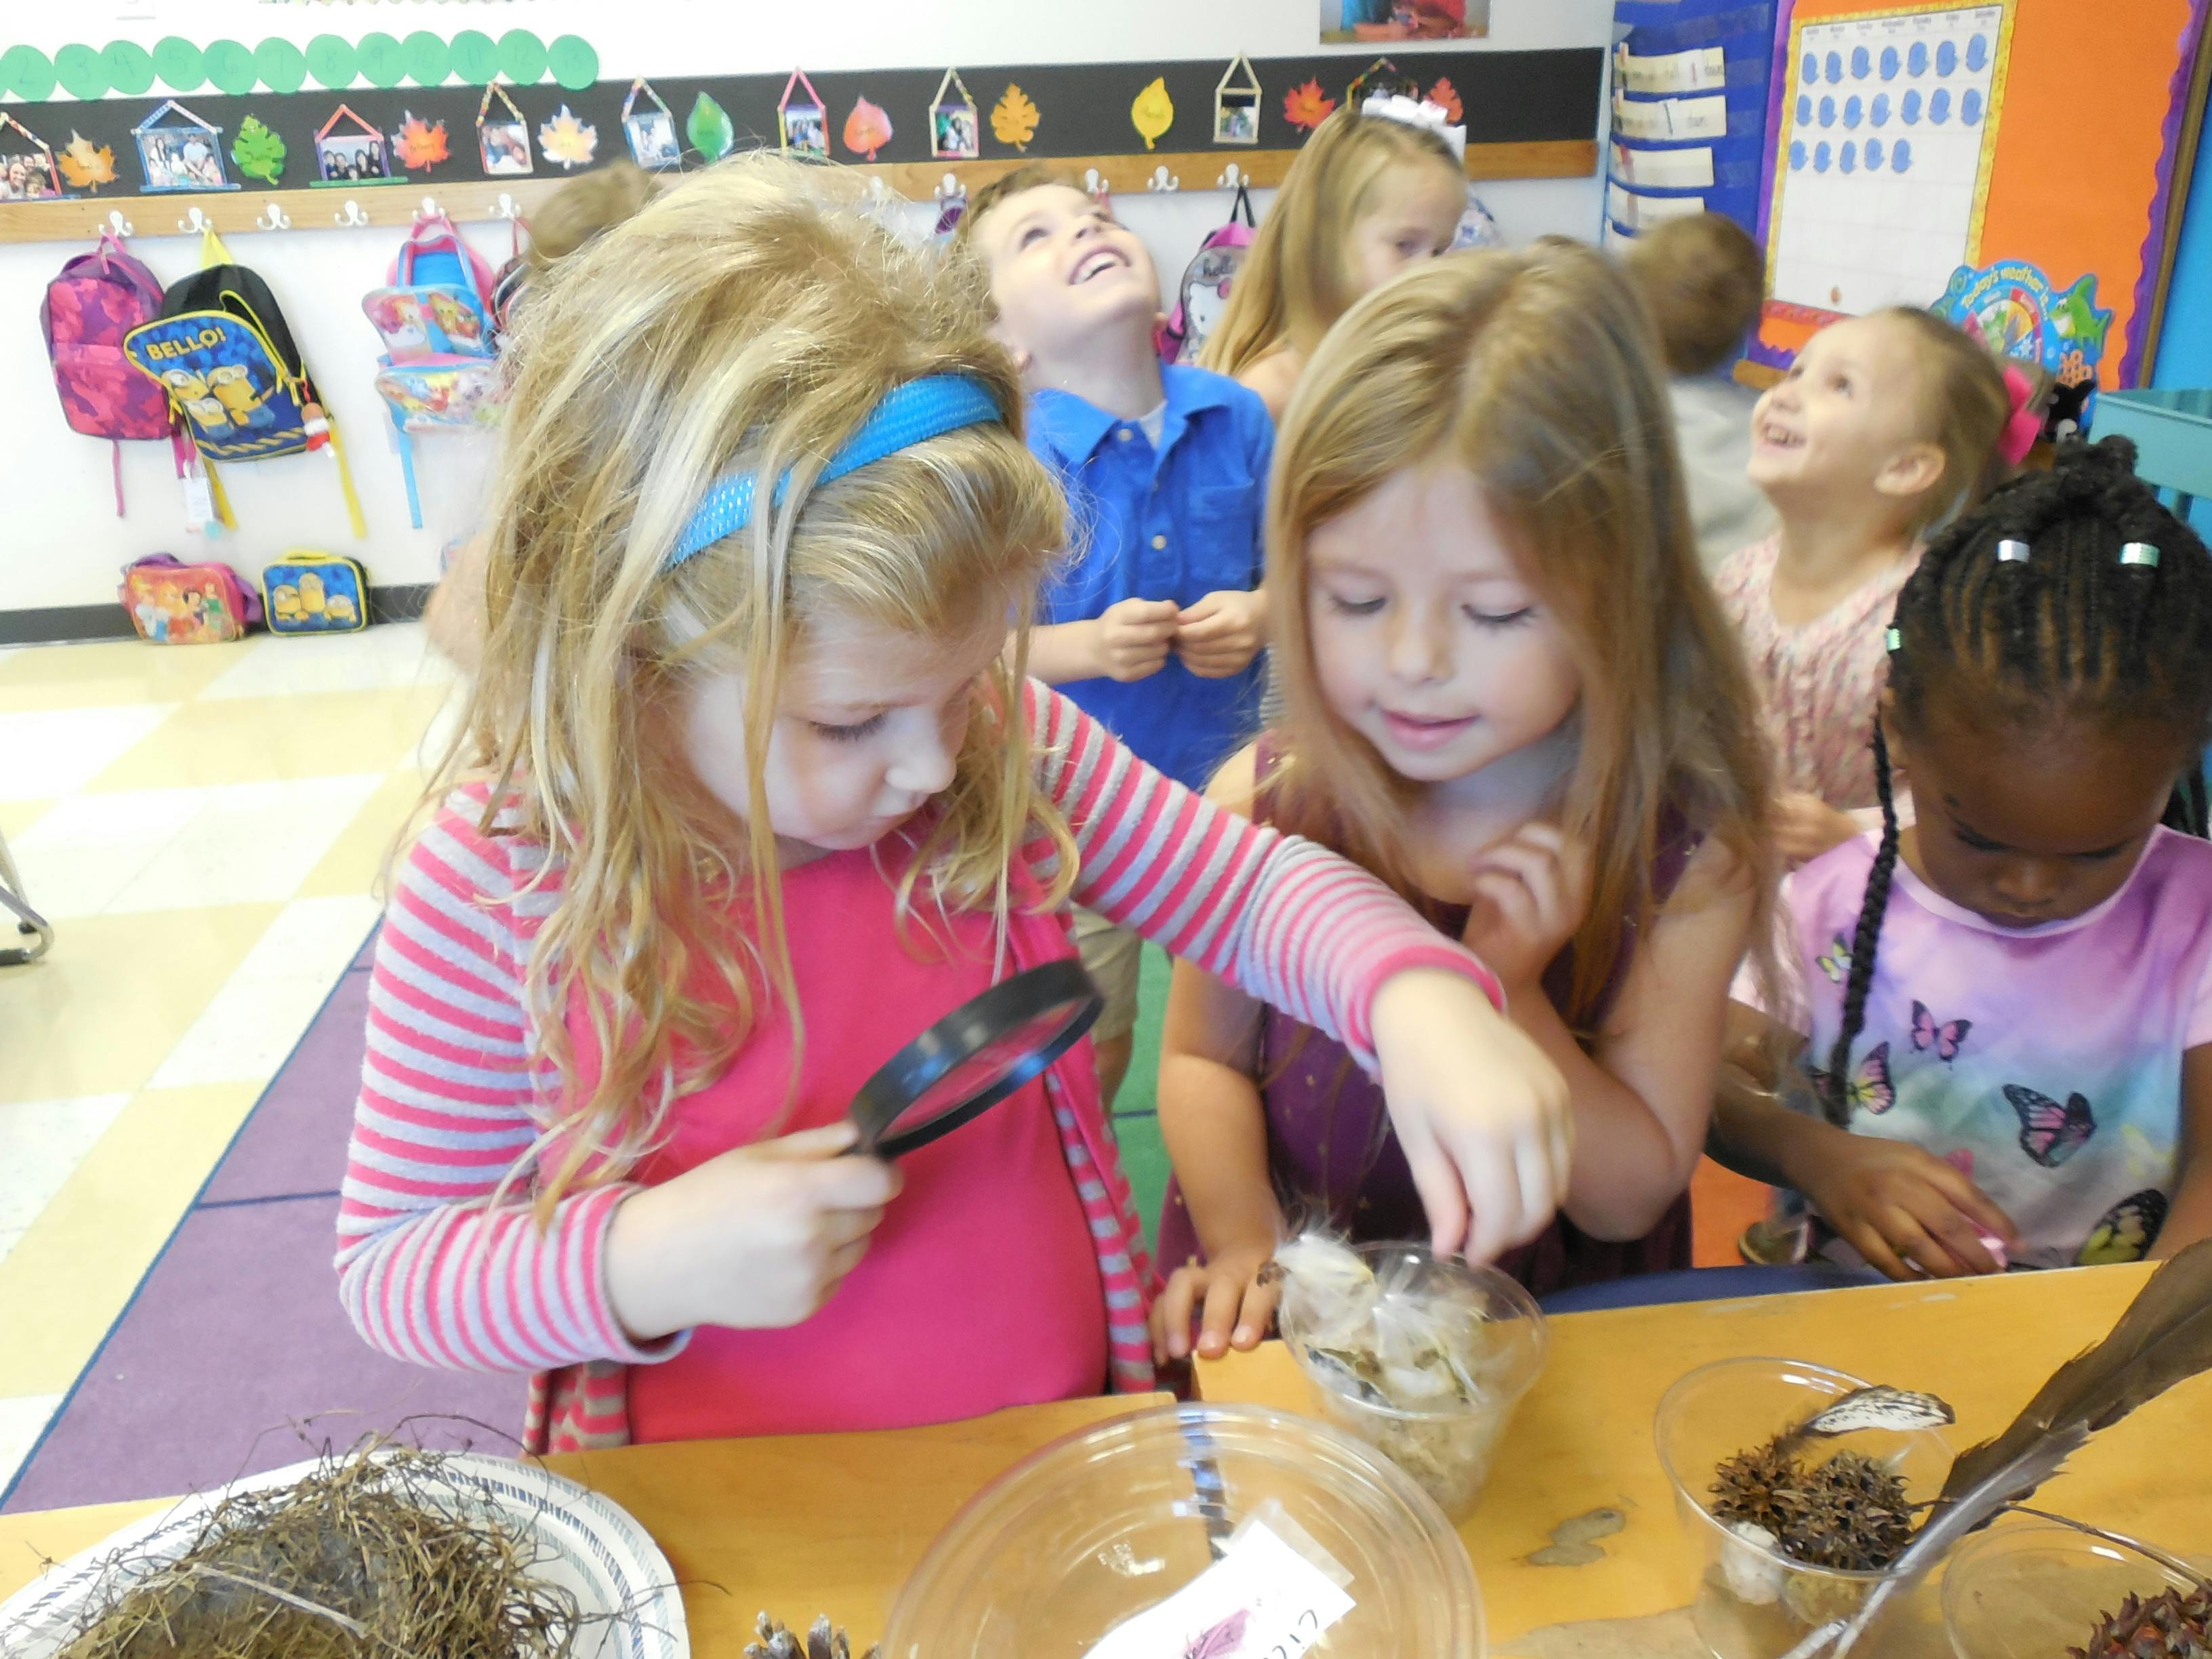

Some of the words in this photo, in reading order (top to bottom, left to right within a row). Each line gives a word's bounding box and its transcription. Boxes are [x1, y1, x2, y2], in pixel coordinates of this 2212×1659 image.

[19, 54, 35, 84] 2
[75, 54, 91, 83] 3
[114, 50, 136, 79] 4
[168, 50, 188, 75] 5
[325, 47, 337, 72] 8
[367, 46, 384, 70] 9
[2001, 266, 2044, 292] weather
[146, 327, 227, 361] BELLO!
